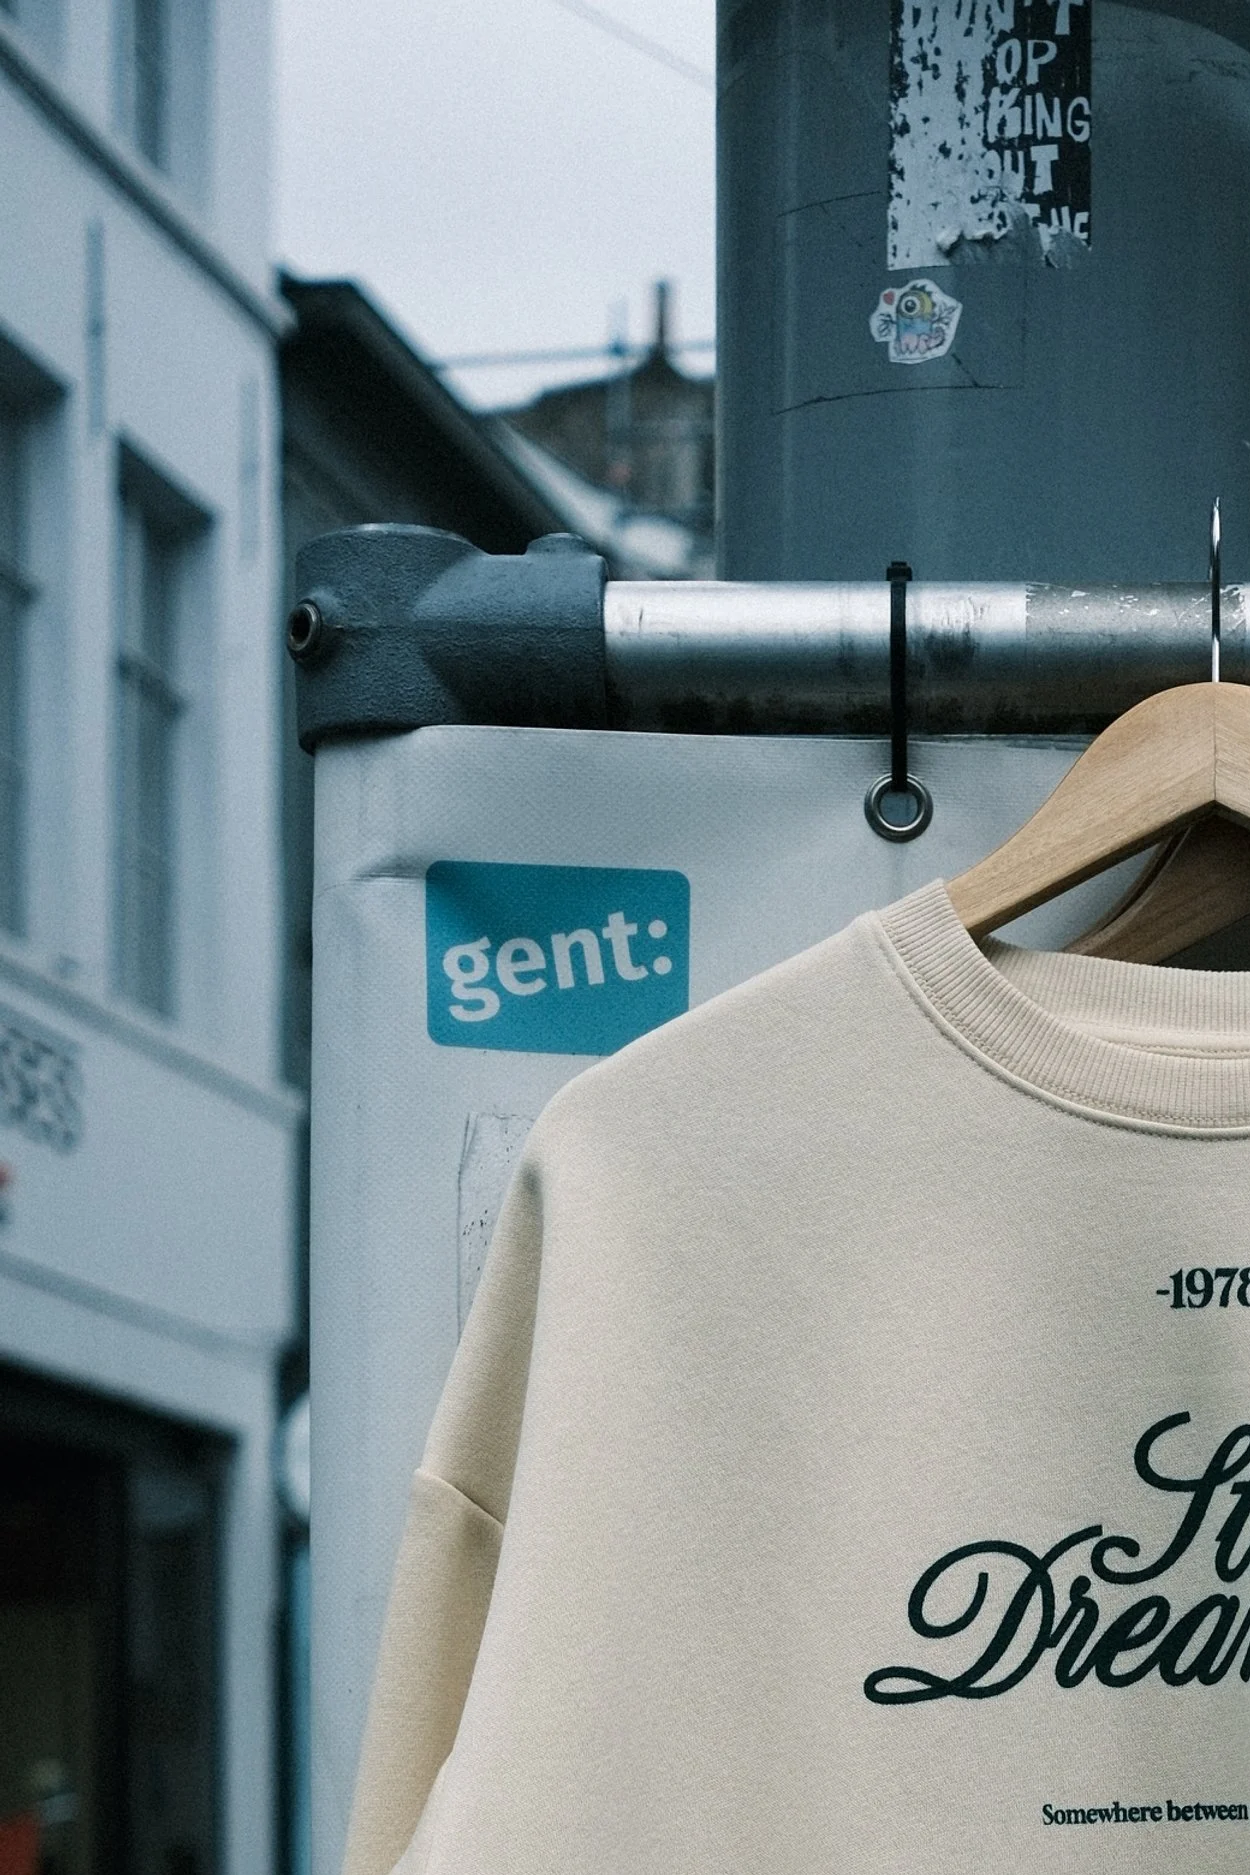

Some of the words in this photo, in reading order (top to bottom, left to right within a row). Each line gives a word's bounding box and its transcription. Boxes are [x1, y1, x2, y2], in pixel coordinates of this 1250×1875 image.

[443, 911, 673, 1022] gent:
[1042, 1800, 1164, 1826] Somewhere
[1165, 1798, 1249, 1823] between
